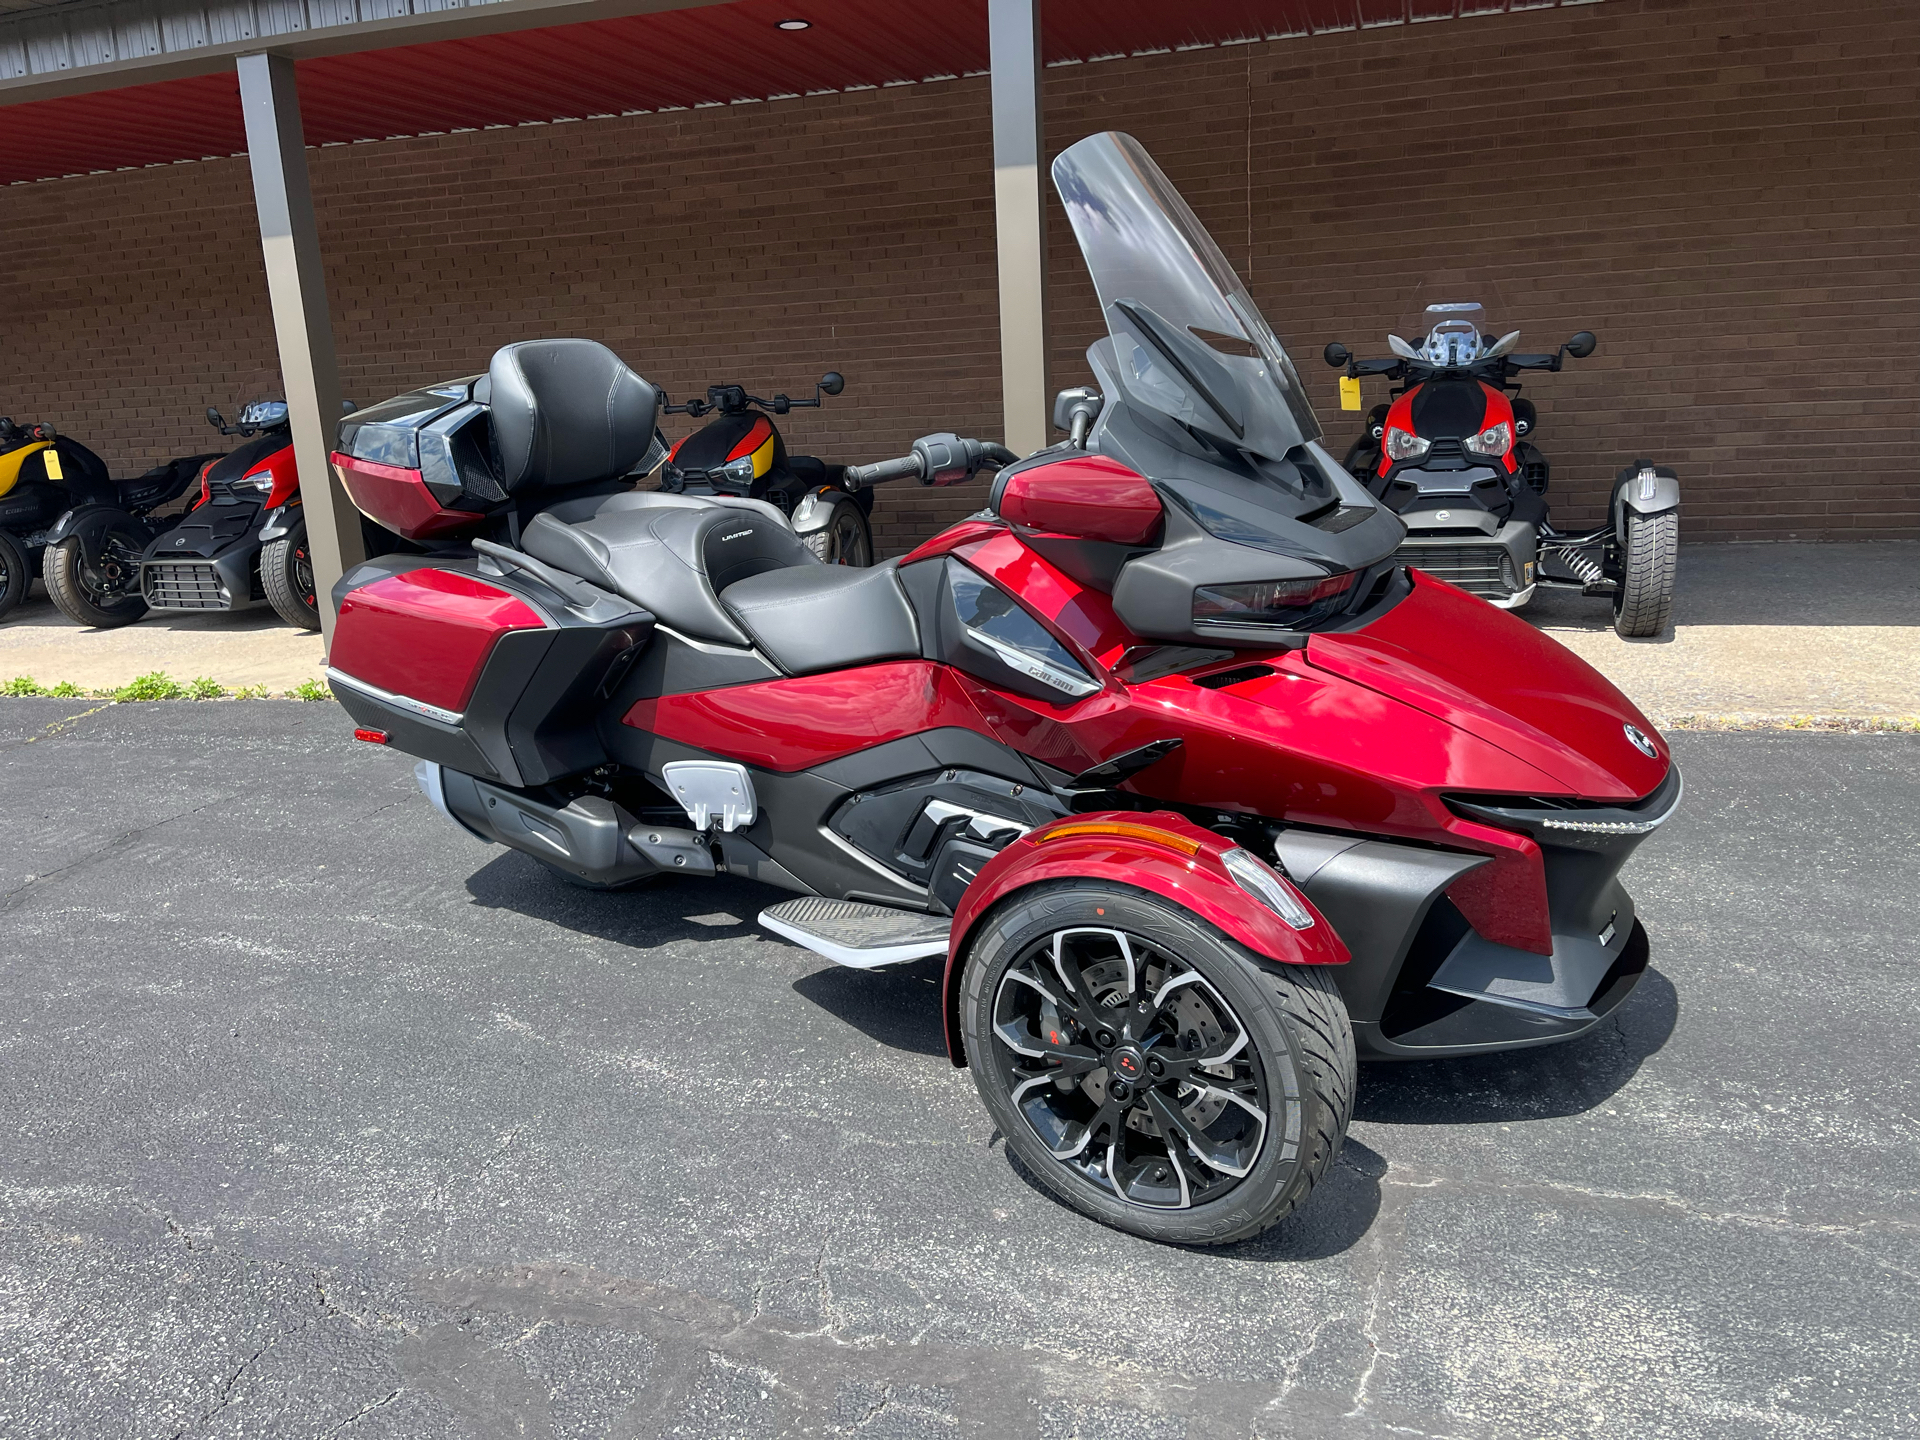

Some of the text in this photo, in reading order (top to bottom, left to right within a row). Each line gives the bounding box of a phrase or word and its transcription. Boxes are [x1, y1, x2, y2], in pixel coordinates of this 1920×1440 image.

[721, 529, 753, 541] LIMITED
[1028, 666, 1074, 691] can-am
[1138, 1207, 1252, 1240] KENDA
